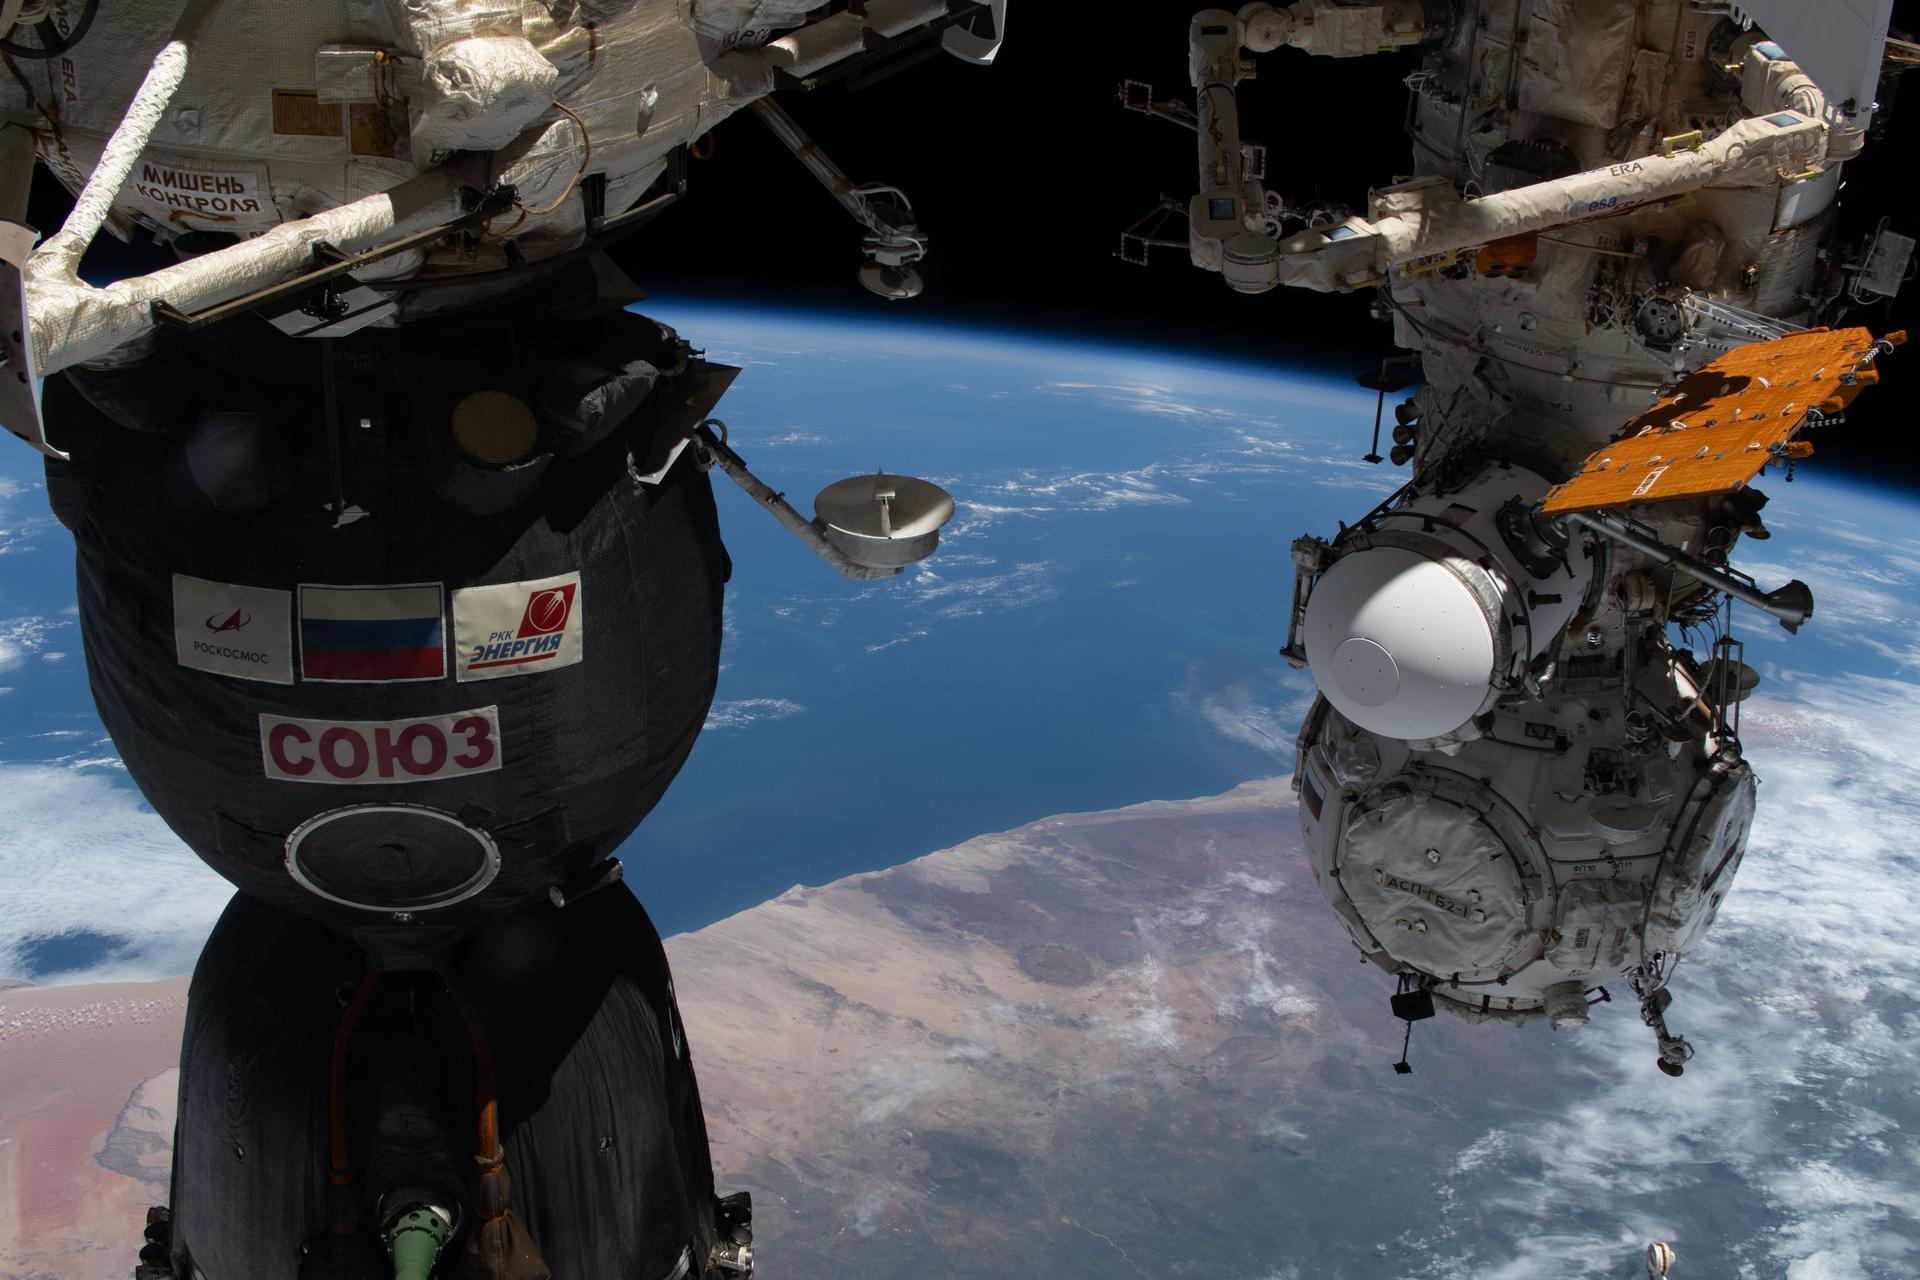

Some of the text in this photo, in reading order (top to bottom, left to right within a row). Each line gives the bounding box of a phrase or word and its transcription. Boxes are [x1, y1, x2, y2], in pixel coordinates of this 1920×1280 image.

[62, 57, 77, 102] ERA
[143, 164, 245, 195] МИШЕНЬ
[1610, 162, 1643, 177] ERA
[136, 183, 260, 213] КОНТРОЛЯ
[1588, 196, 1617, 212] esa
[470, 633, 564, 662] ЭНЕРГИЯ
[489, 630, 514, 642] РКК
[193, 640, 268, 664] РОСКОСМОС
[269, 716, 495, 779] СОЮЗ
